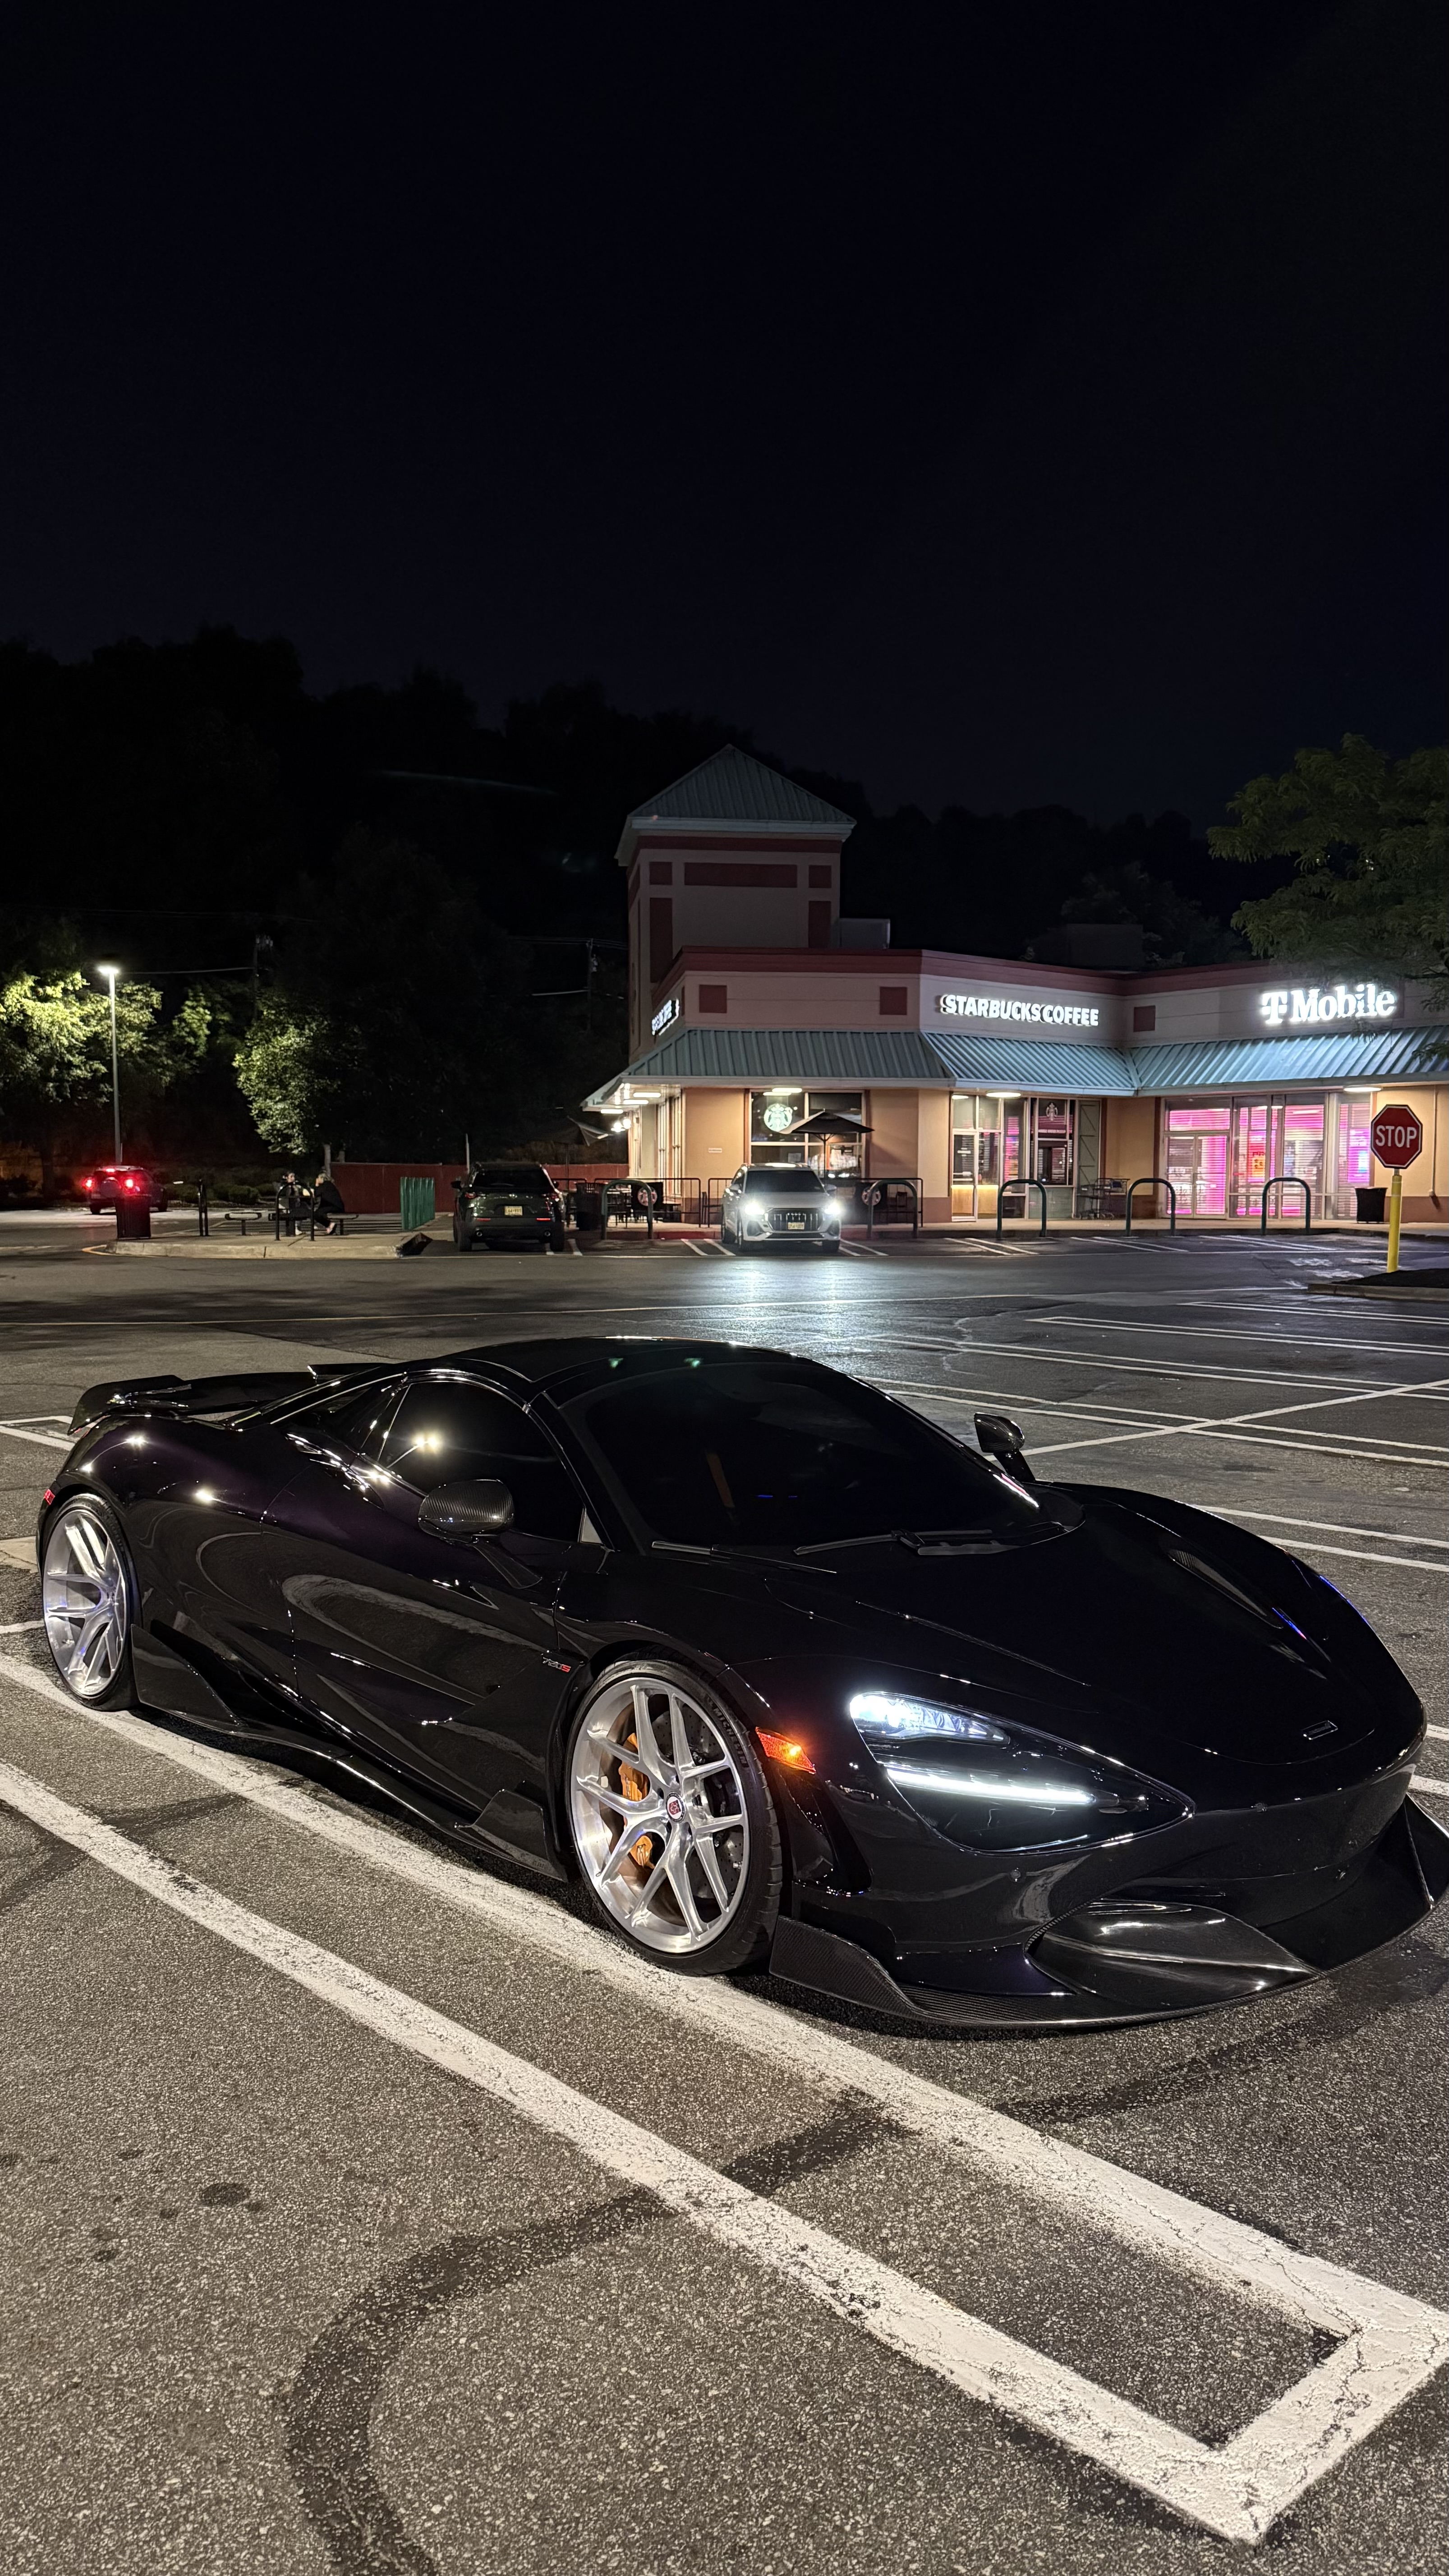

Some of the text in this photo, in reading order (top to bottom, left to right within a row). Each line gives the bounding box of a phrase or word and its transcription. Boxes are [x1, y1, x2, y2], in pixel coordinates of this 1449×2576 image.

[941, 994, 1099, 1026] STARBUCKS COFFEE
[1375, 1125, 1417, 1148] STOP
